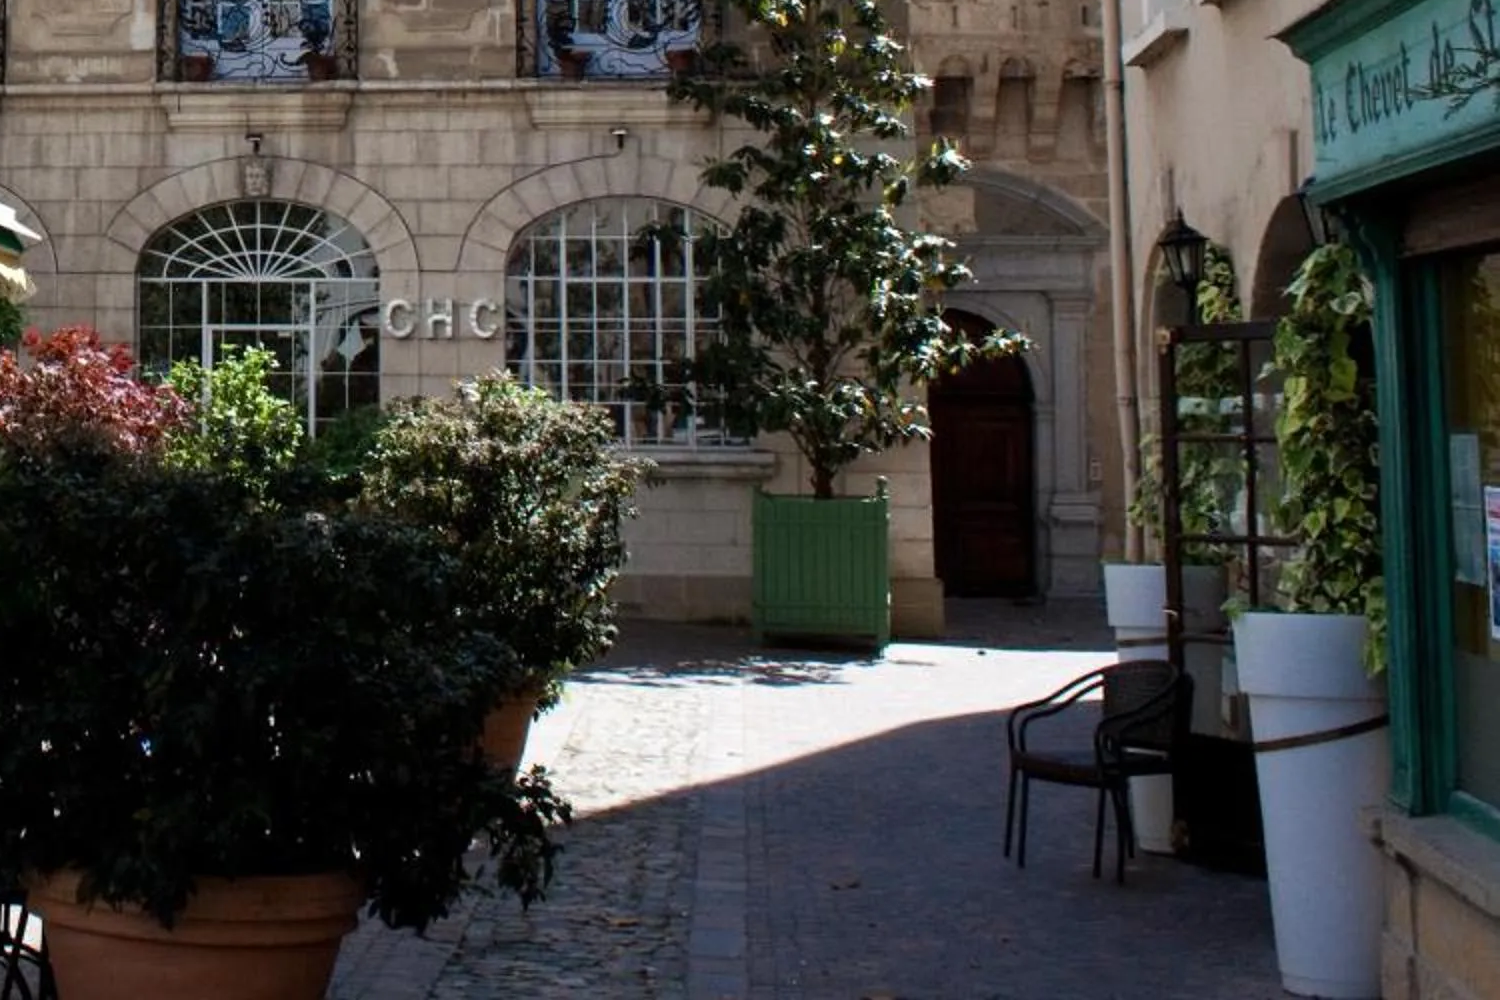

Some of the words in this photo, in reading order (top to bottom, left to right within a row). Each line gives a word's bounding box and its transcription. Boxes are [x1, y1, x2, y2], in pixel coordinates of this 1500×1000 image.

[1316, 81, 1337, 147] Le
[1345, 40, 1413, 136] Chevet
[1429, 20, 1455, 97] de
[387, 298, 498, 339] CHC
